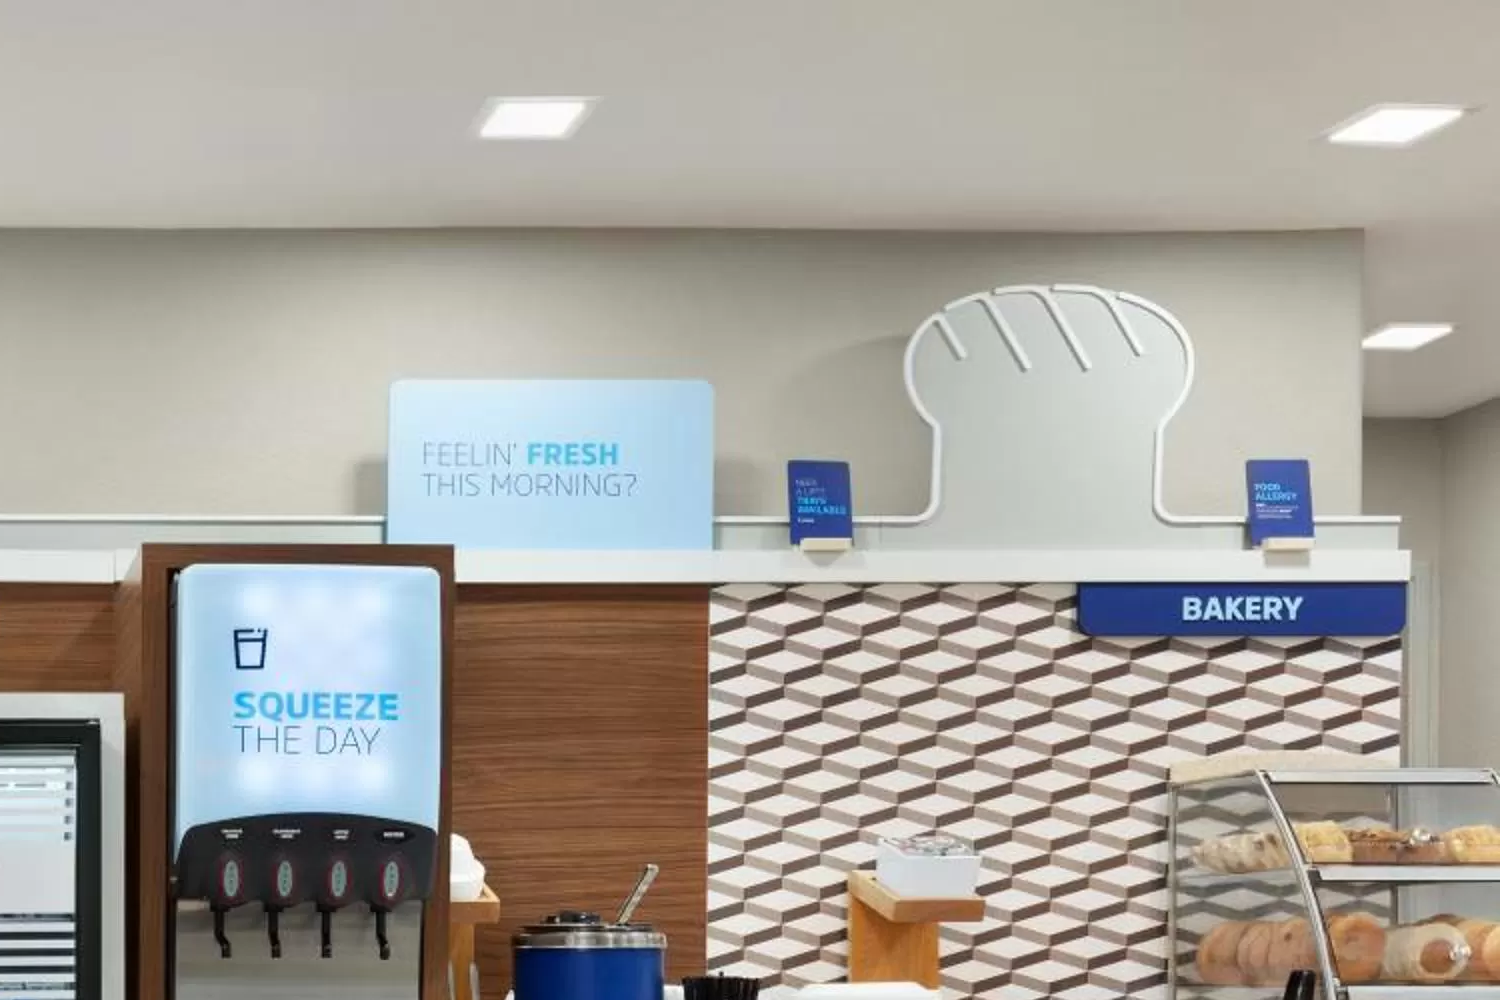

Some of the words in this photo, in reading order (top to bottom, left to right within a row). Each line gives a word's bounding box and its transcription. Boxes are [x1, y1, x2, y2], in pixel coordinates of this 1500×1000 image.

[422, 441, 517, 467] FEELIN'
[527, 442, 619, 466] FRESH
[420, 472, 481, 497] THIS
[490, 472, 638, 497] MORNING?
[1182, 596, 1304, 621] BAKERY
[233, 691, 399, 723] SQUEEZE
[232, 725, 302, 755] THE
[315, 725, 381, 756] DAY
